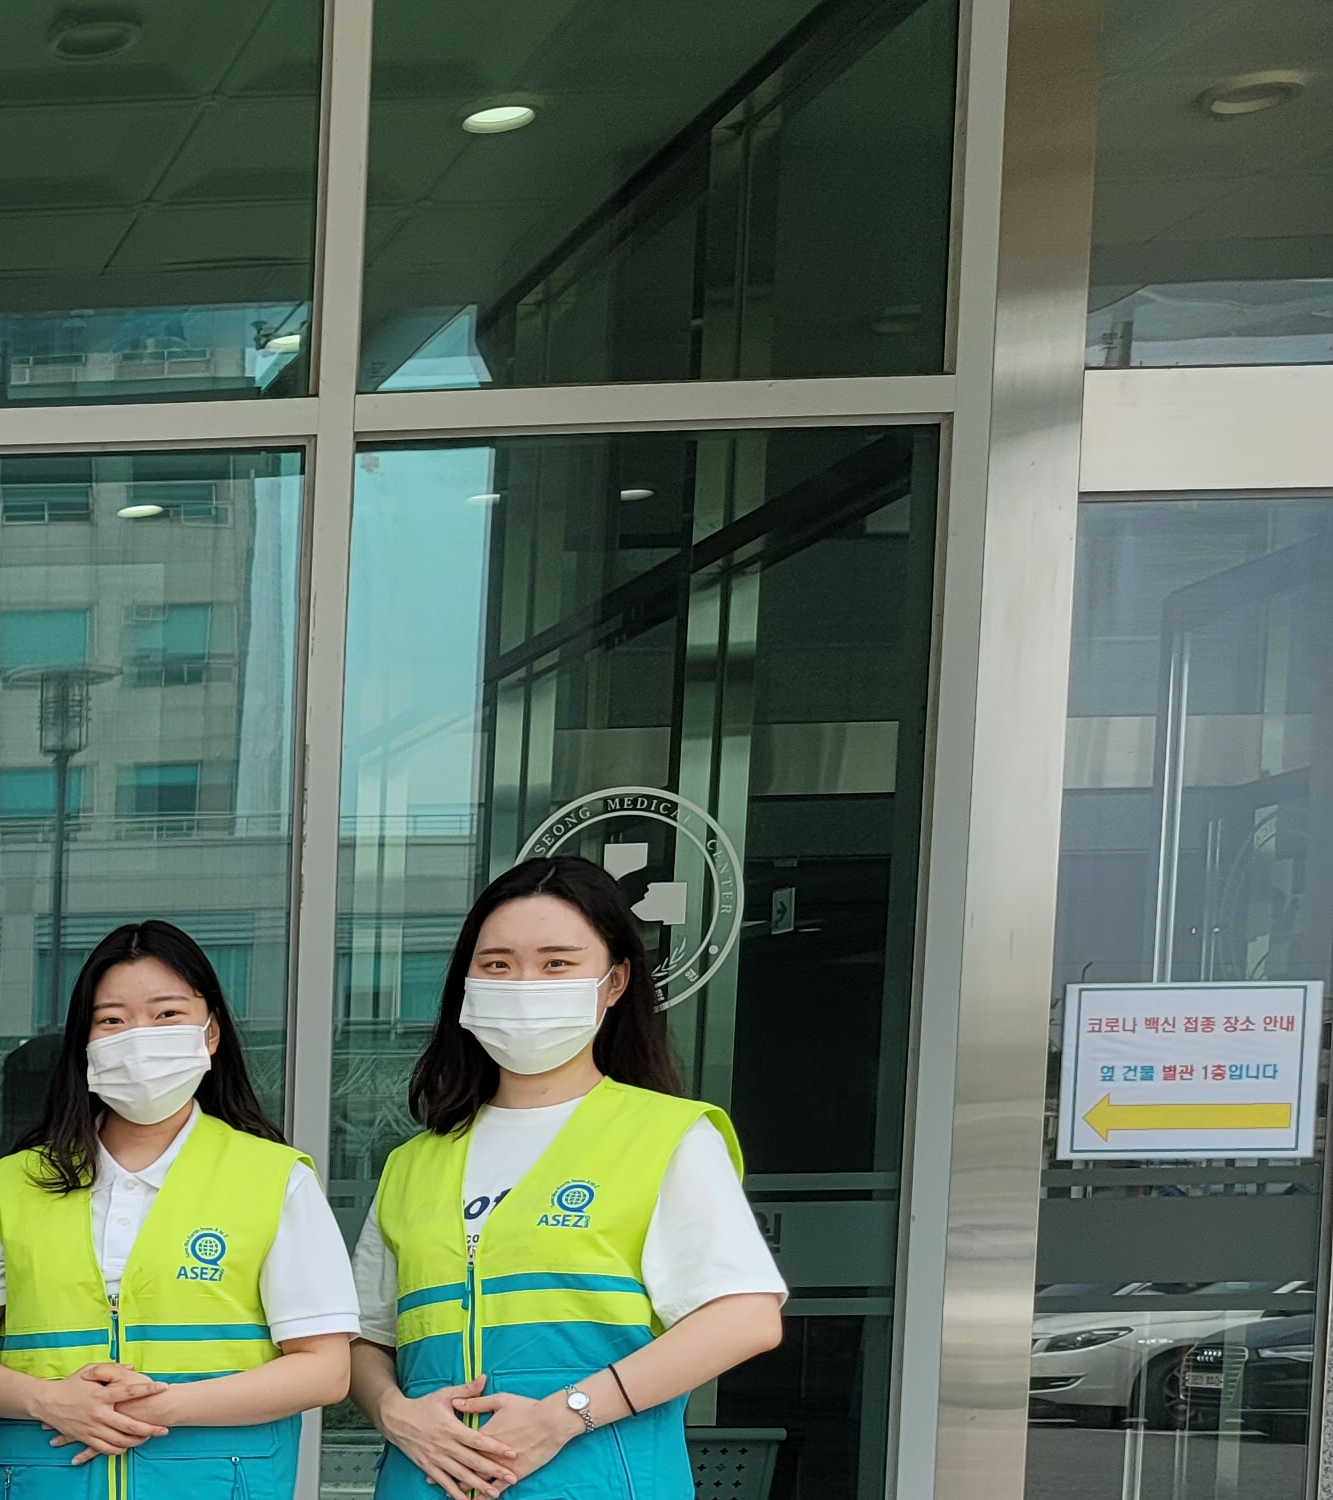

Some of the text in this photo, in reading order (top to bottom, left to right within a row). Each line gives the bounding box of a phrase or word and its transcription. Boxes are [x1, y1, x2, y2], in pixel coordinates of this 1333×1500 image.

[535, 806, 591, 854] SEONG
[1087, 1016, 1295, 1033] 코로나 백신 접종 장소 안내
[1100, 1064, 1278, 1082] 옆 건물 별관 1층입니다
